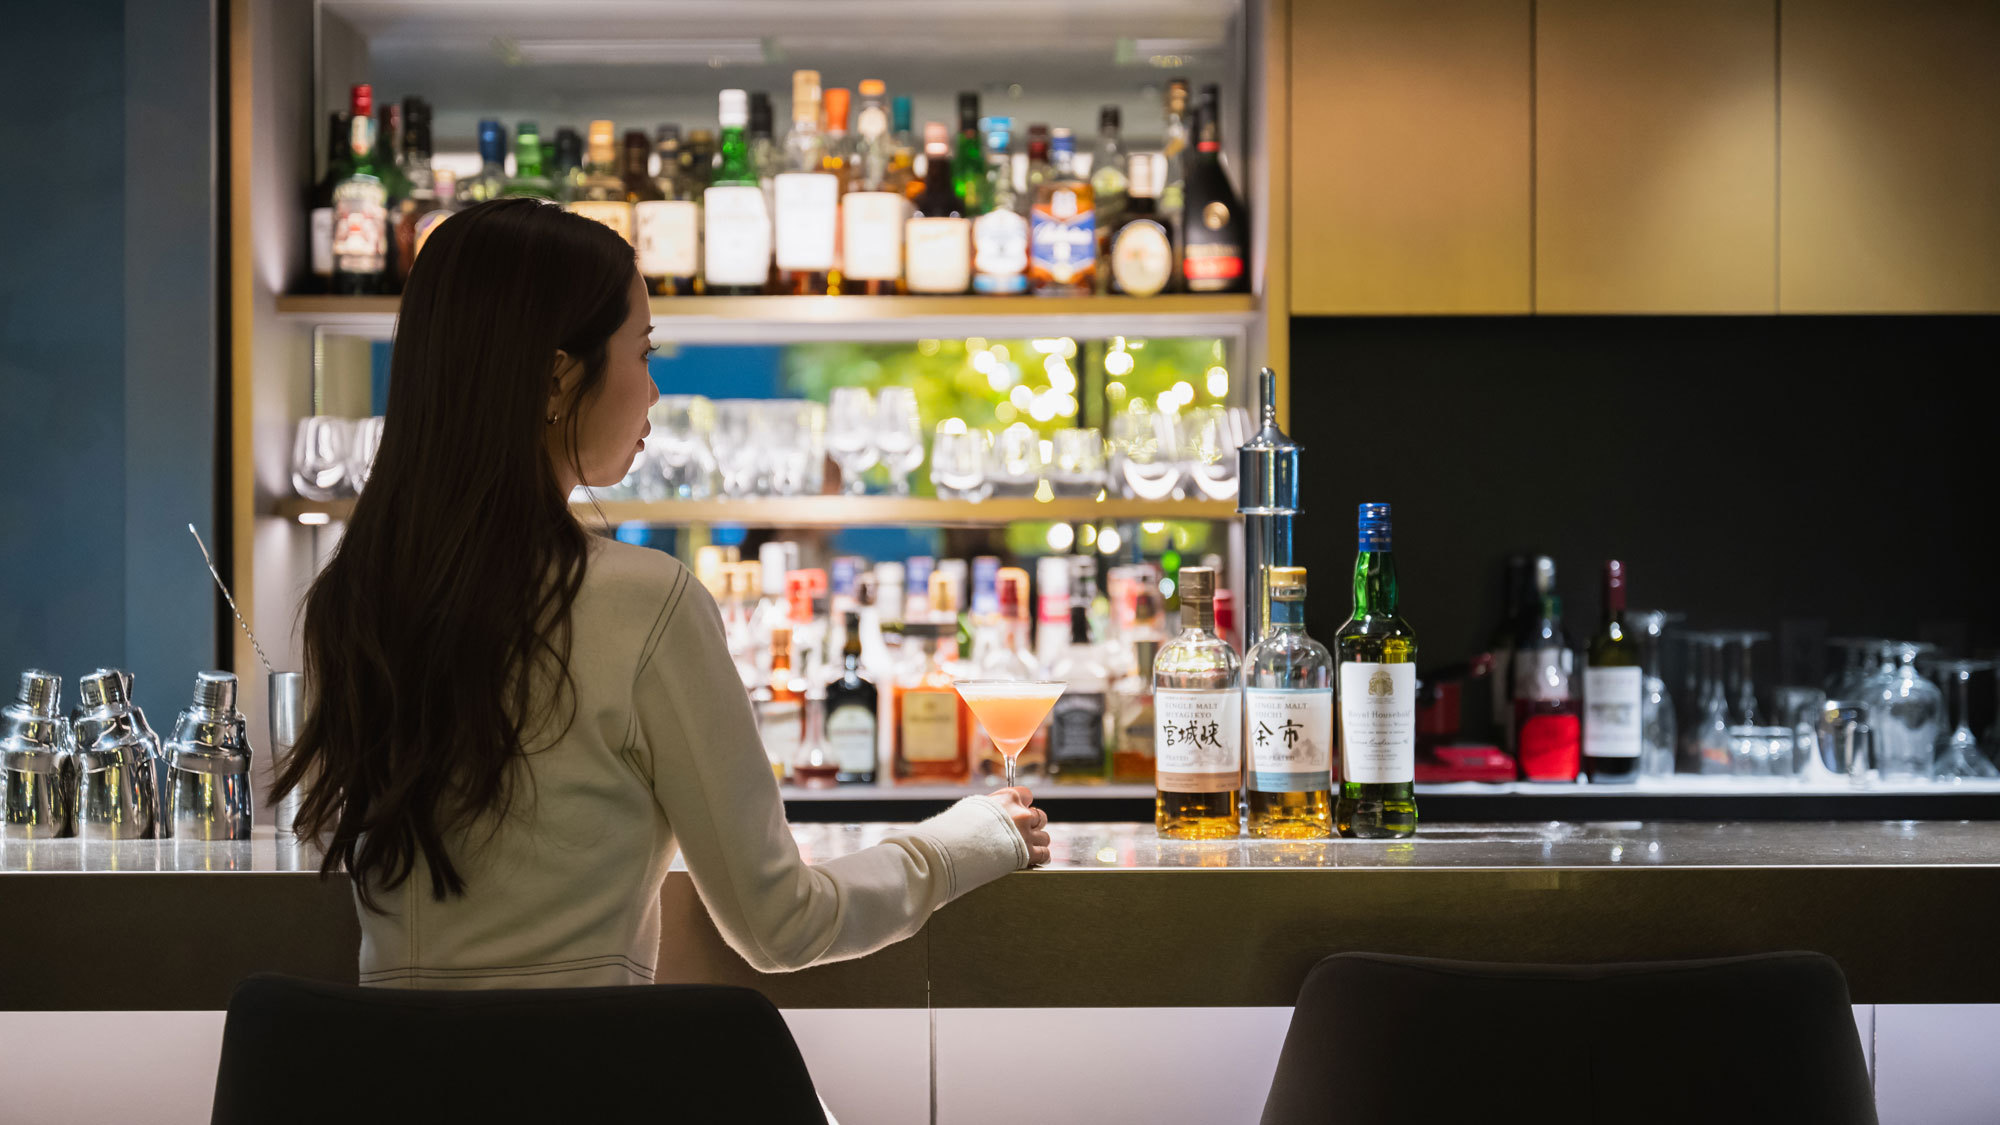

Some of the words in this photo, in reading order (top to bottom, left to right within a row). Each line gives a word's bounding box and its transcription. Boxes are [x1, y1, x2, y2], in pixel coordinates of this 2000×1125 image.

[1285, 702, 1308, 710] MALT
[1163, 720, 1222, 750] 宮城峡
[1252, 719, 1304, 750] 余市
